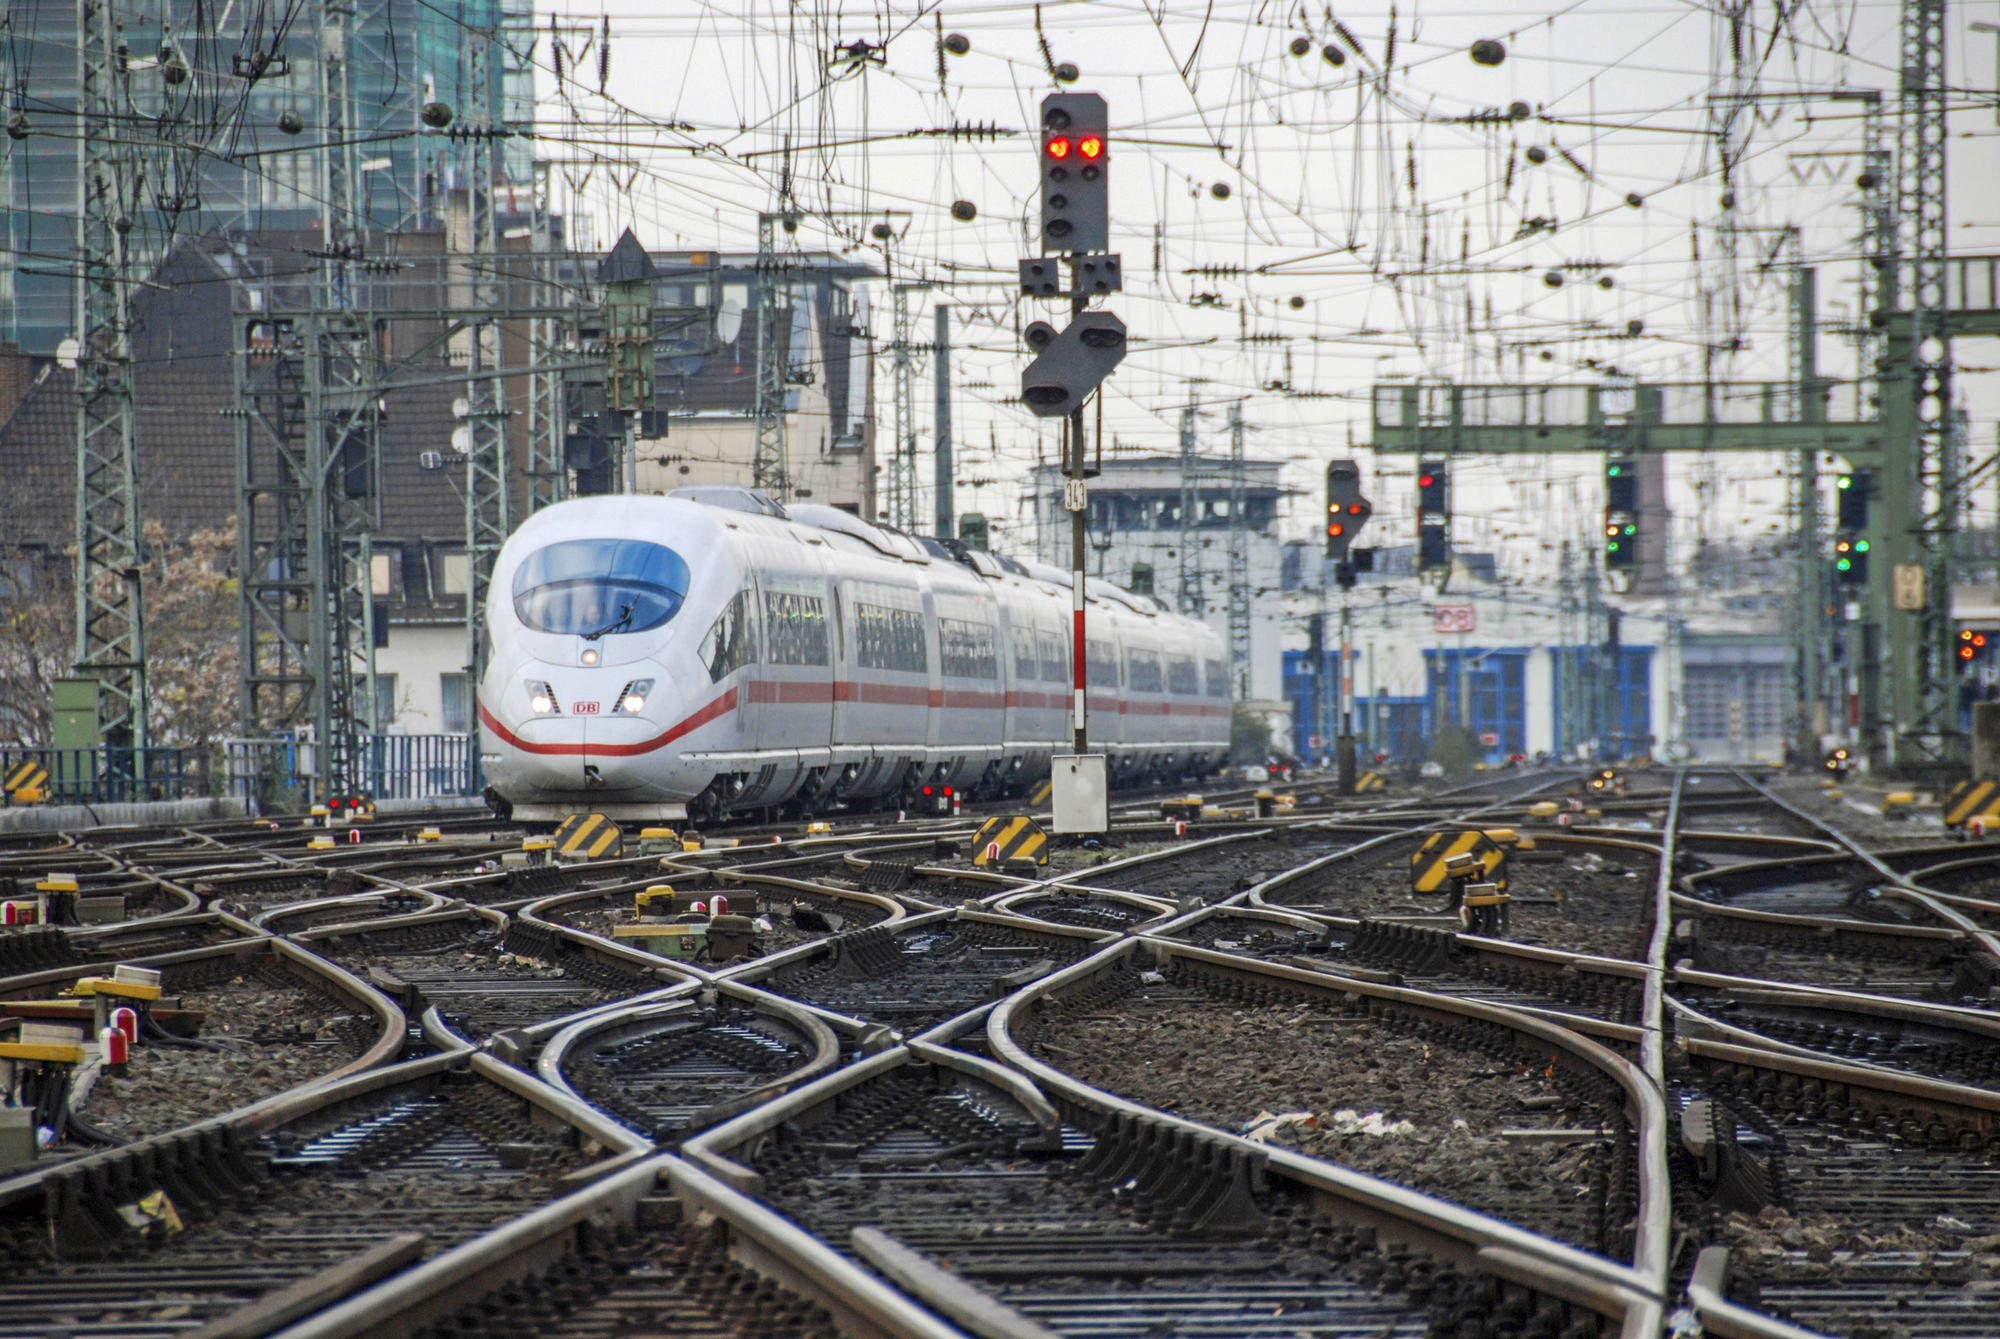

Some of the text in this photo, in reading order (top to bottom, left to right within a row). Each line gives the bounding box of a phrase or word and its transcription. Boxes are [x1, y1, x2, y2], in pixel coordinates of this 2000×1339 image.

[1066, 482, 1085, 507] 343
[1440, 608, 1470, 629] DB
[576, 703, 597, 713] DB
